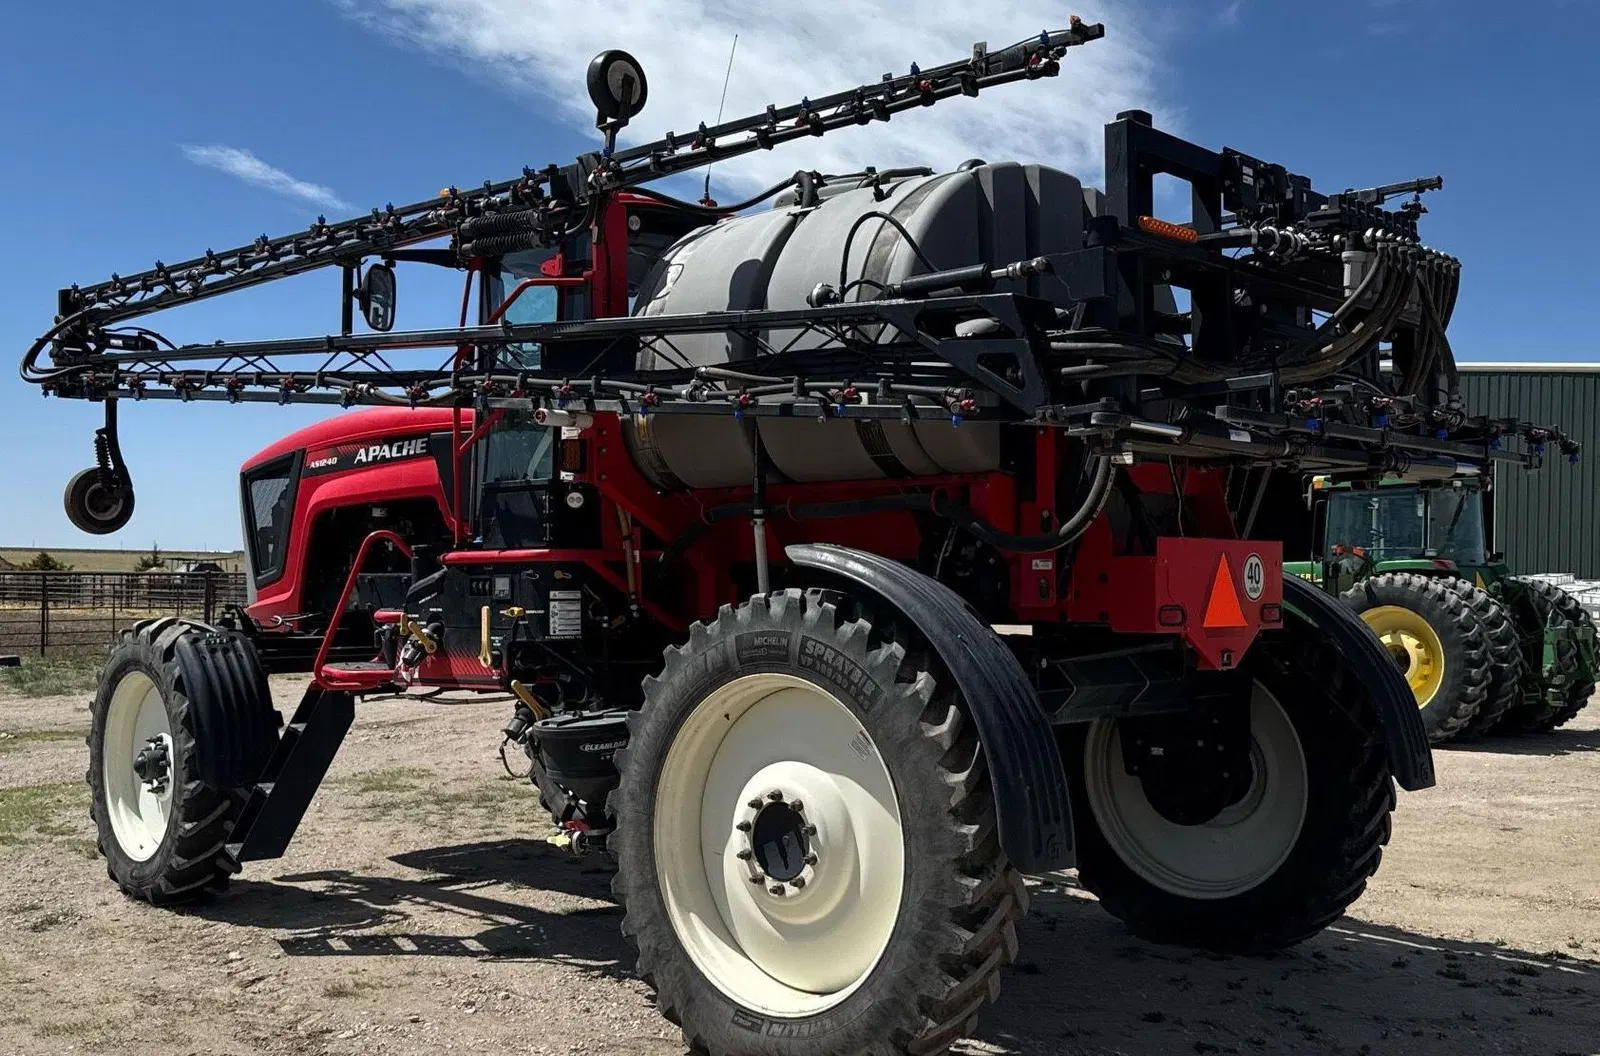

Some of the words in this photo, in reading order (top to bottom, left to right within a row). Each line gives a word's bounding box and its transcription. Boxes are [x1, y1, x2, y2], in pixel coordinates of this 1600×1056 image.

[354, 438, 428, 464] APACHE
[309, 457, 338, 469] AS1240
[1247, 562, 1261, 585] 40
[754, 636, 788, 647] MICHELIN
[805, 640, 876, 697] SPRAYBIB
